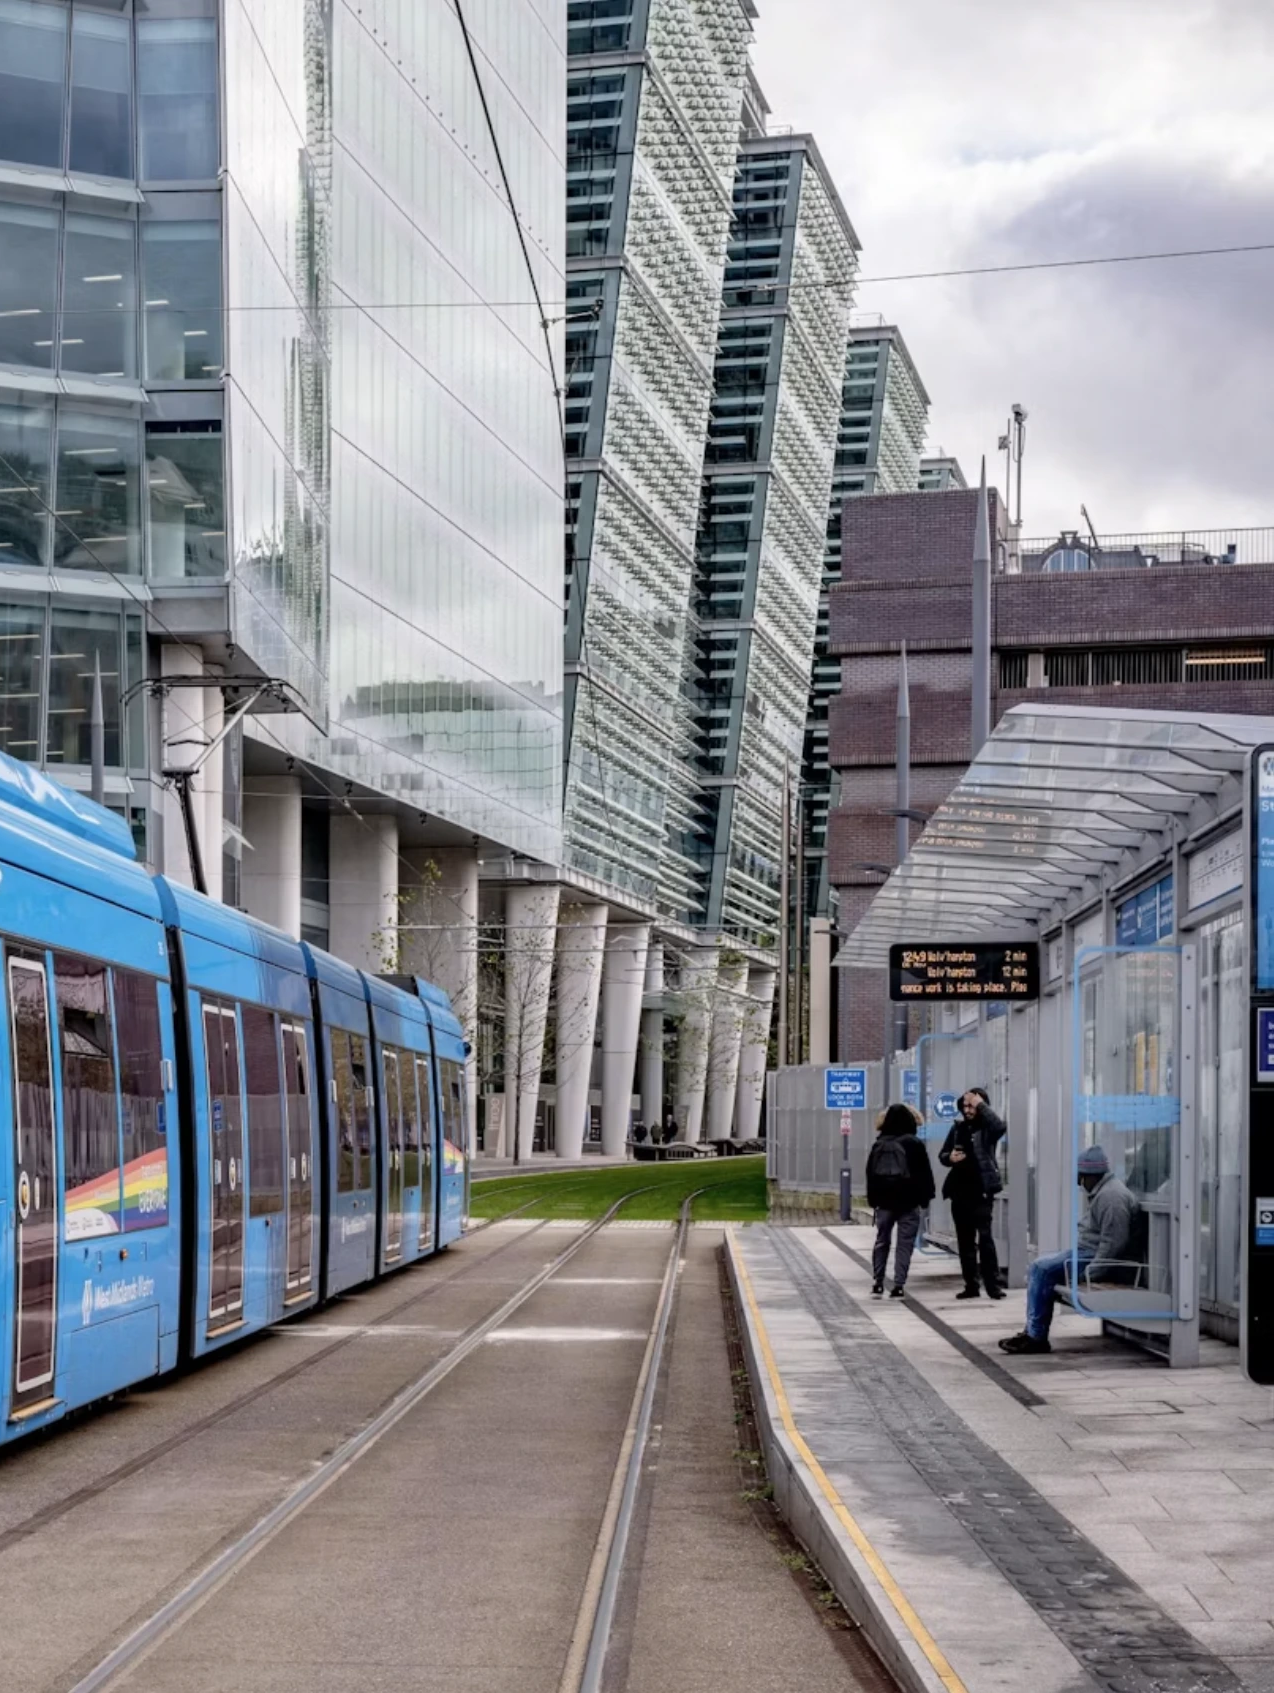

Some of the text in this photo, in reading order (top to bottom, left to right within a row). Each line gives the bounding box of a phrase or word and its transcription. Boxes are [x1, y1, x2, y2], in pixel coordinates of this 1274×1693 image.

[1005, 950, 1011, 962] 2
[1012, 950, 1027, 962] min
[1002, 966, 1011, 977] 12
[1012, 966, 1027, 977] min
[945, 982, 955, 993] is
[956, 982, 982, 994] taking
